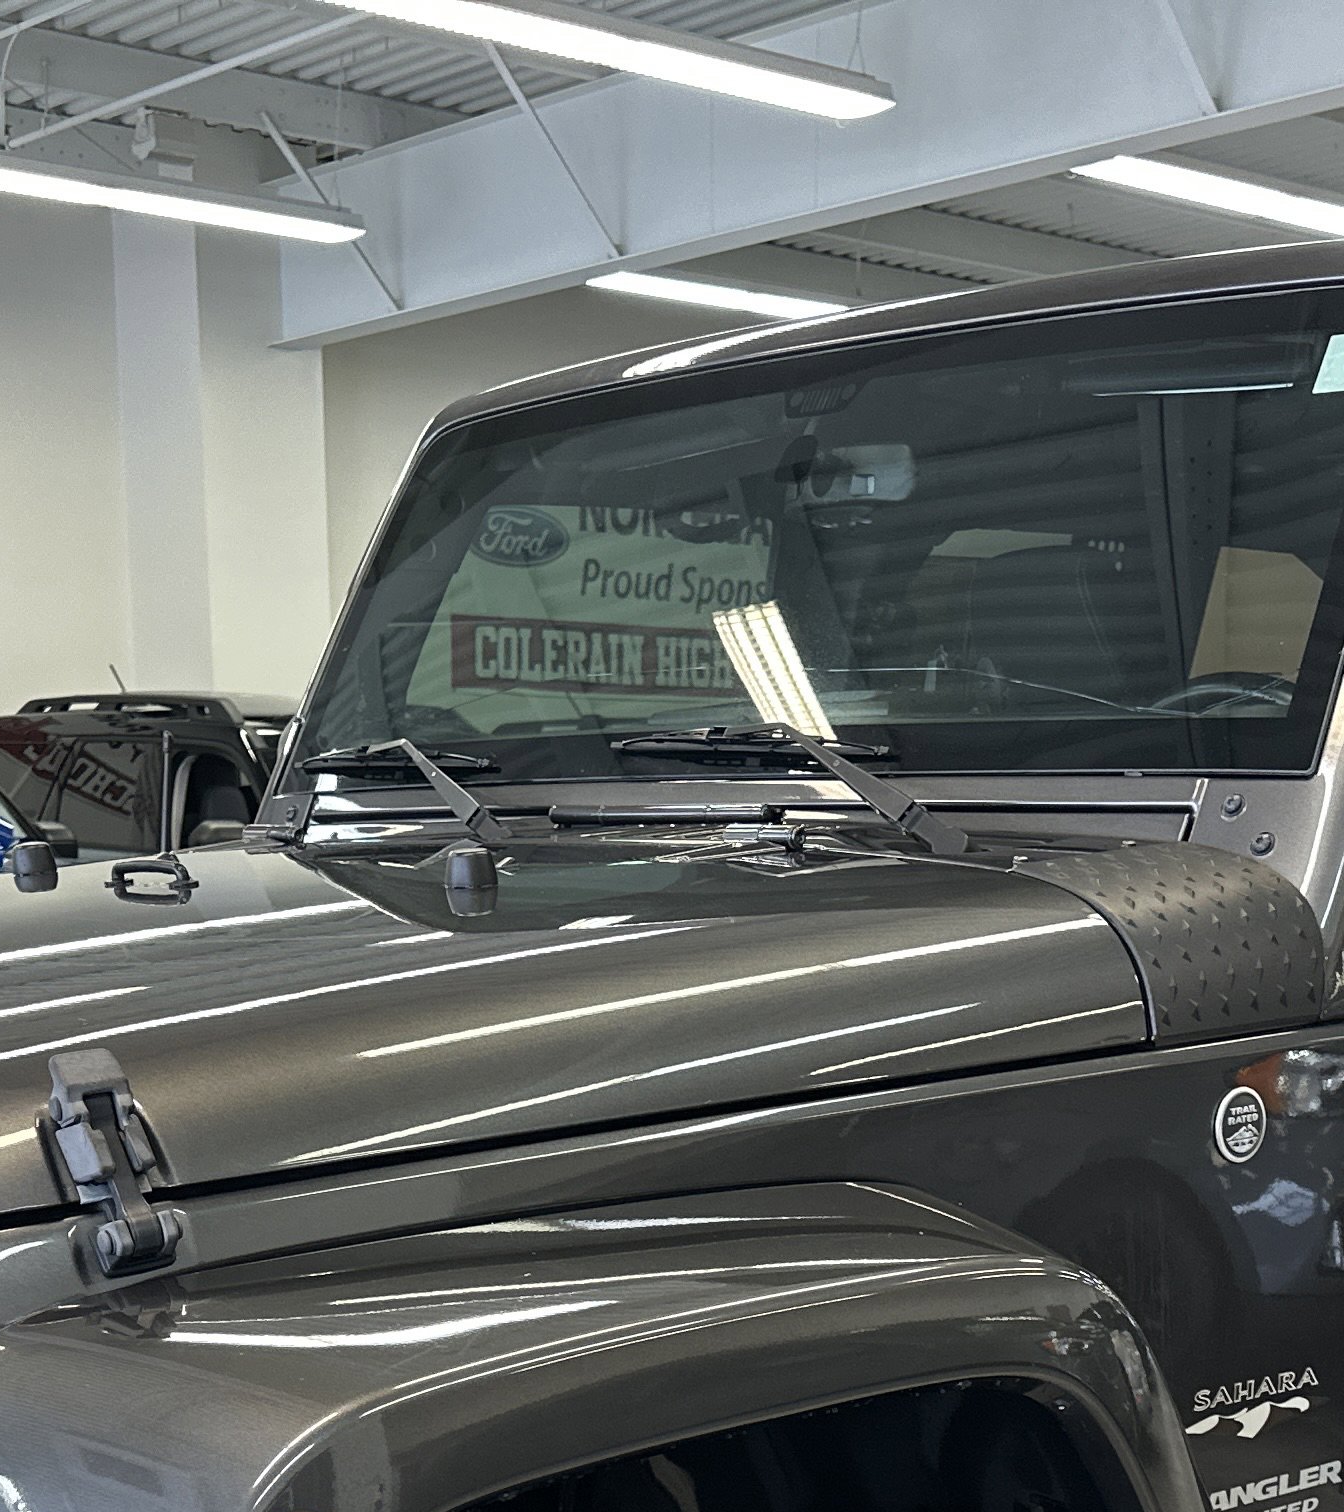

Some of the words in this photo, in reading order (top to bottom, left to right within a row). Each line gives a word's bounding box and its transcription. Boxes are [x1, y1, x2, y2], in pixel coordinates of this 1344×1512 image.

[479, 511, 550, 557] Ford
[581, 558, 673, 601] Proud
[474, 625, 645, 686] COLERAIN
[1227, 1113, 1259, 1126] RATED
[1229, 1104, 1258, 1116] TRAIL
[1193, 1366, 1319, 1412] SAHARA
